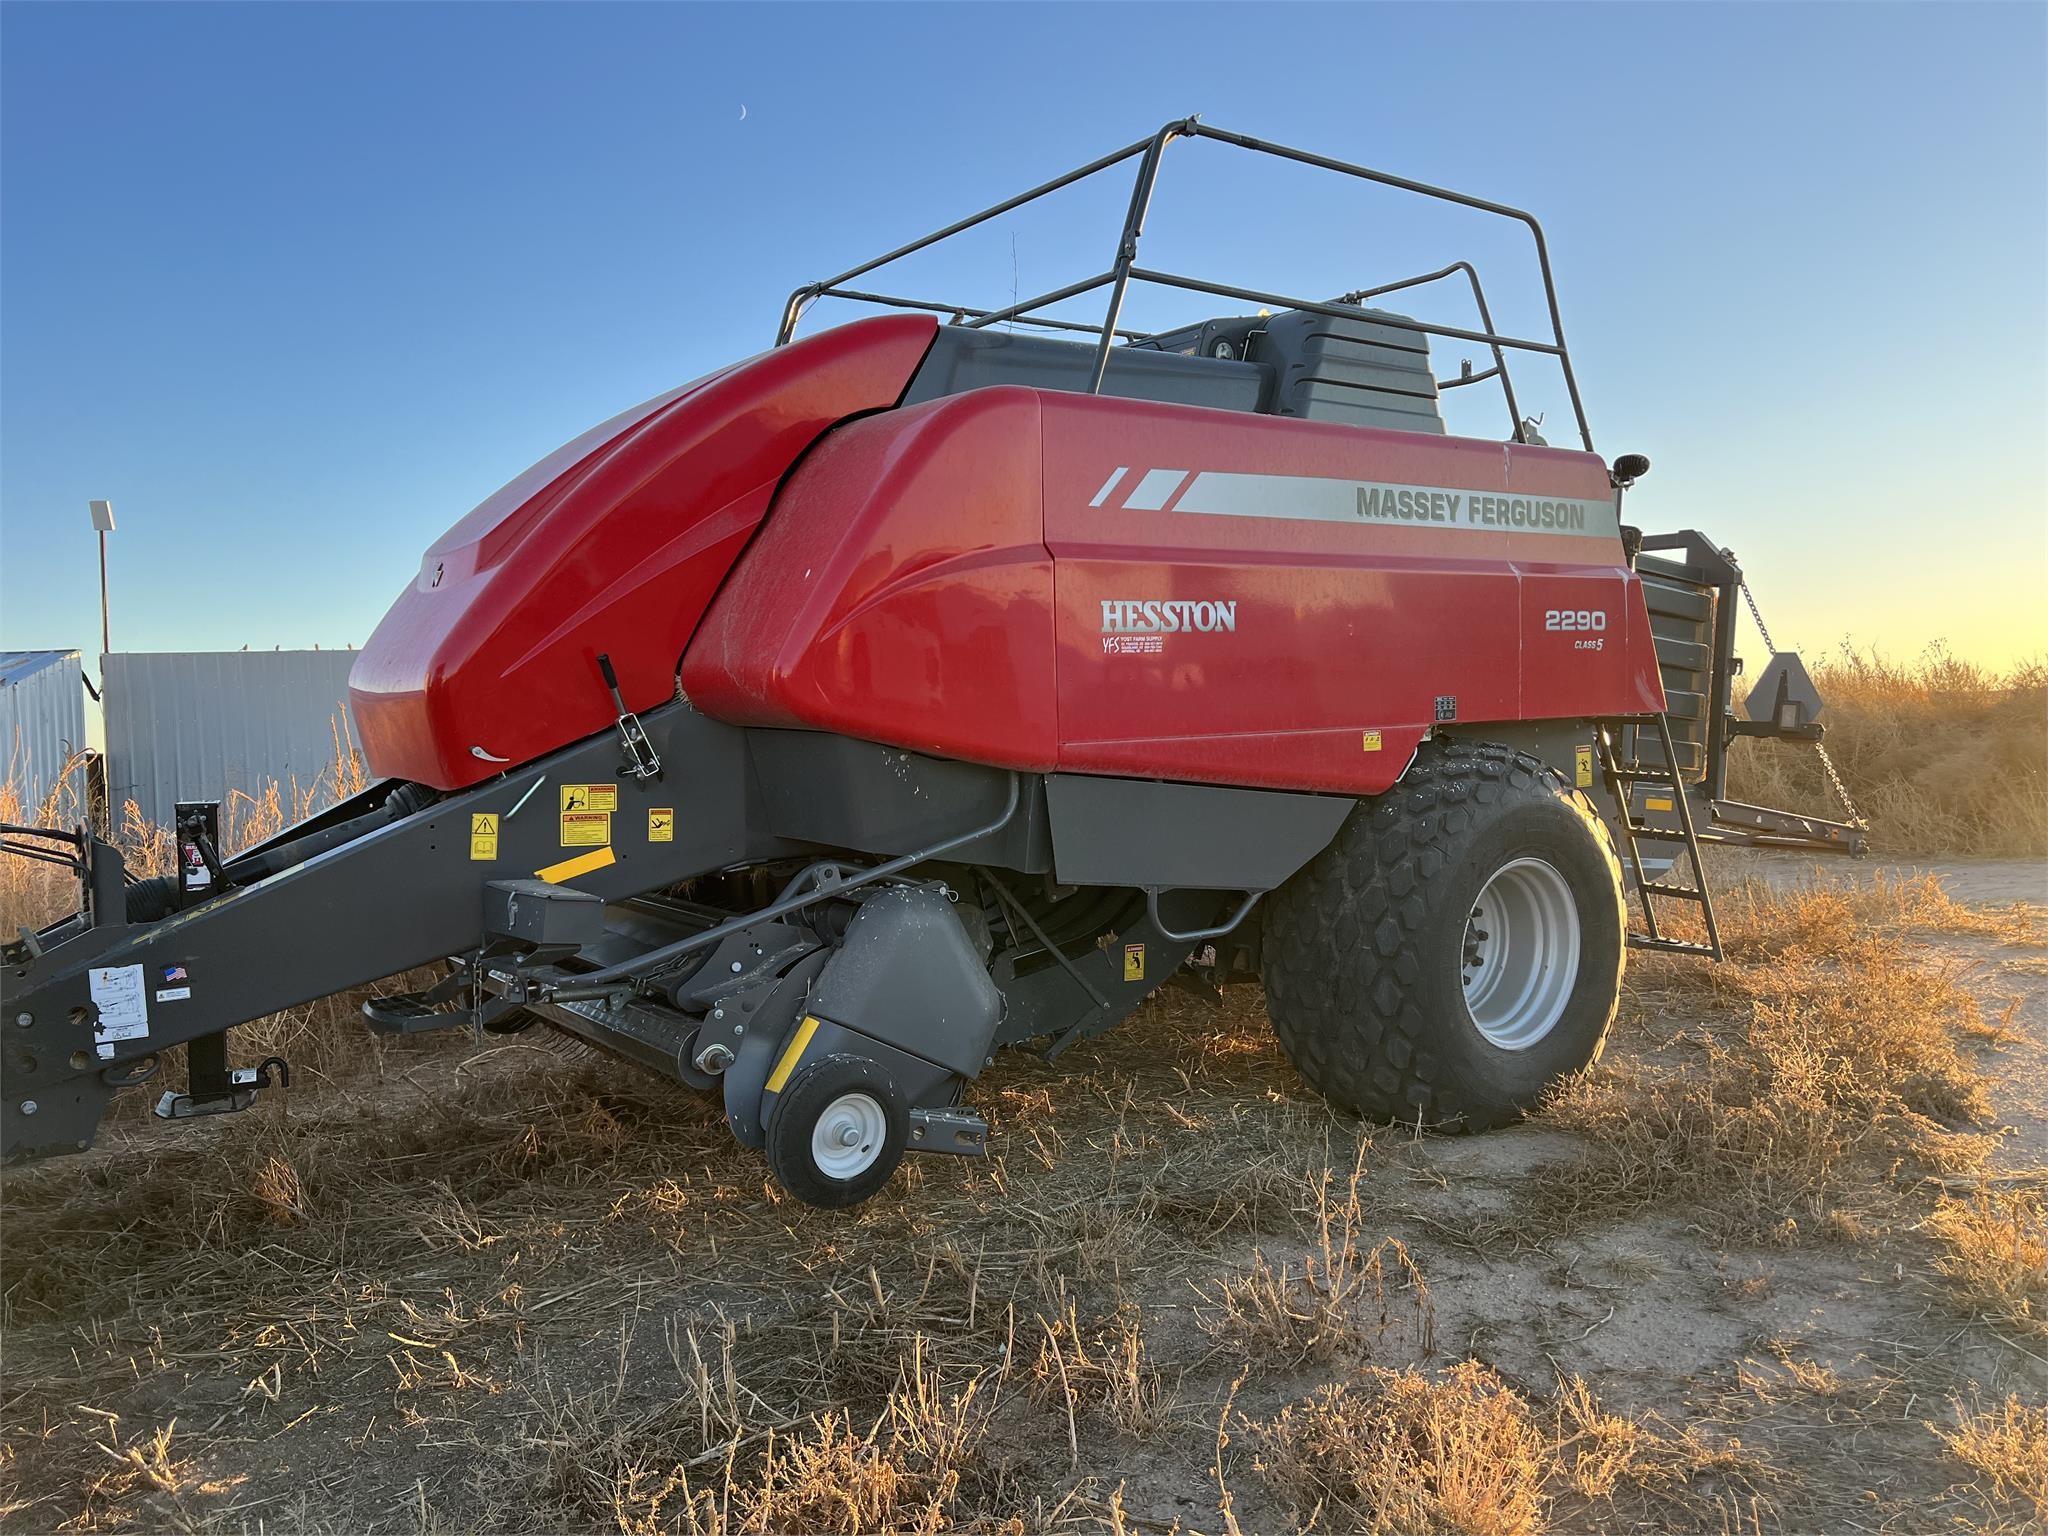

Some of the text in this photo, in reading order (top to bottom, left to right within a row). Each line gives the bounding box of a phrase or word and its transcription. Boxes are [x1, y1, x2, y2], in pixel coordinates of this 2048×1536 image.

[1356, 487, 1585, 530] MASSEY FERGUSON
[1101, 600, 1237, 632] HESSTON
[1545, 610, 1606, 631] 2290
[1102, 636, 1120, 654] YFS
